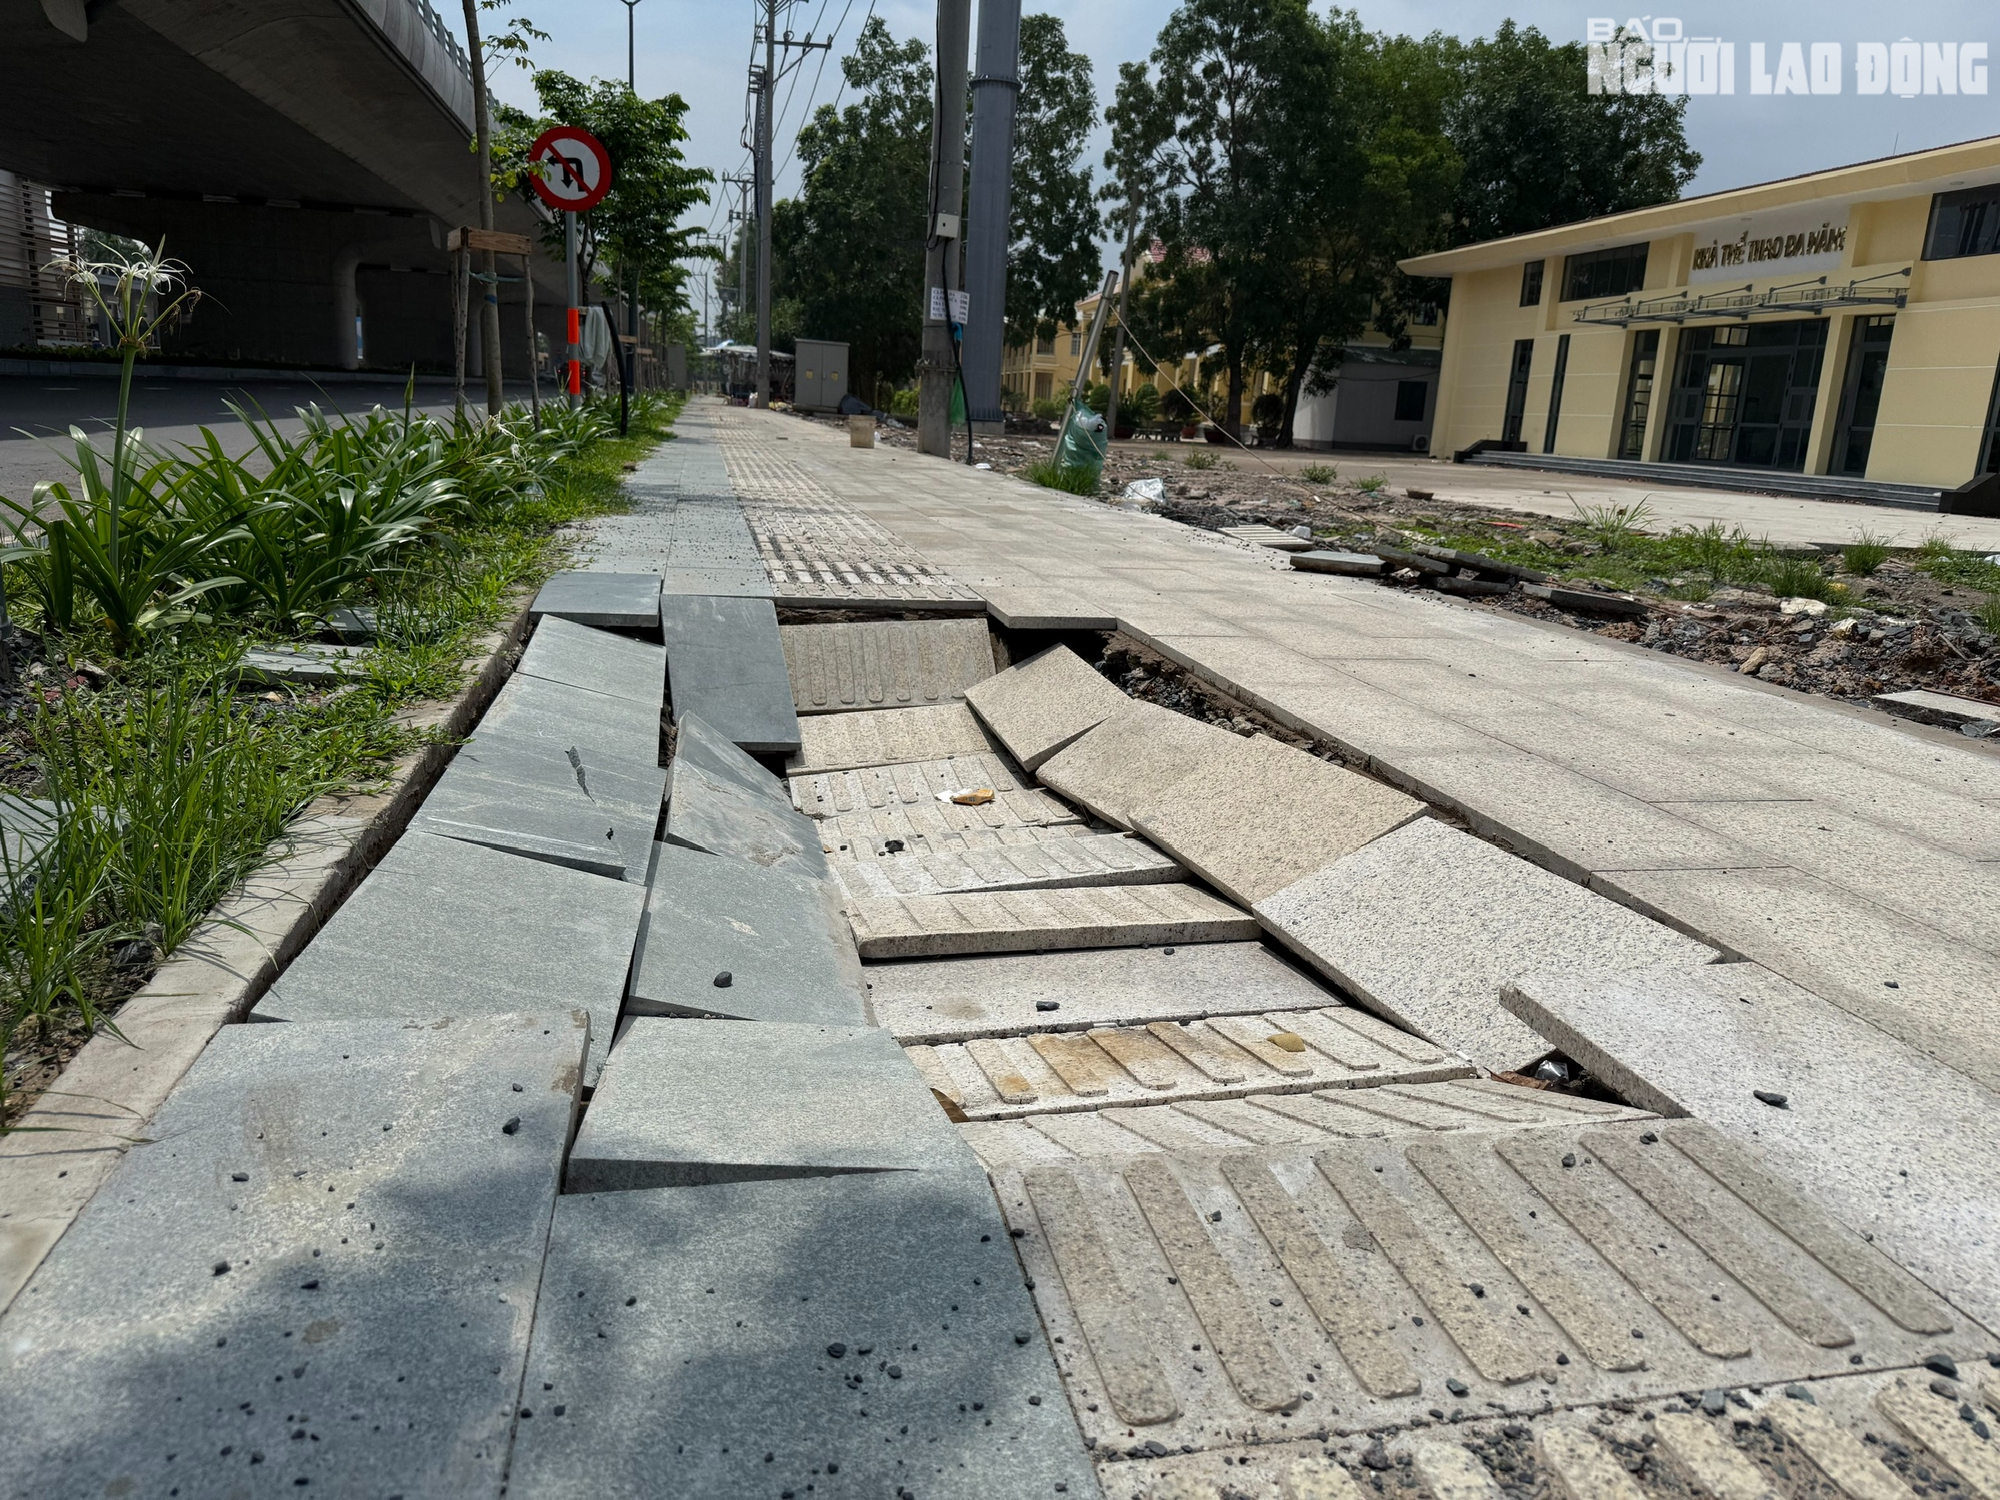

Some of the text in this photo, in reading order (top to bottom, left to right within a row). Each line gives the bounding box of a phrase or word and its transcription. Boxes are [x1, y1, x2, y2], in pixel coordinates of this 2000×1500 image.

[1721, 230, 1749, 267] THỂ
[1747, 236, 1784, 263] THAO
[1784, 233, 1804, 258] ĐA
